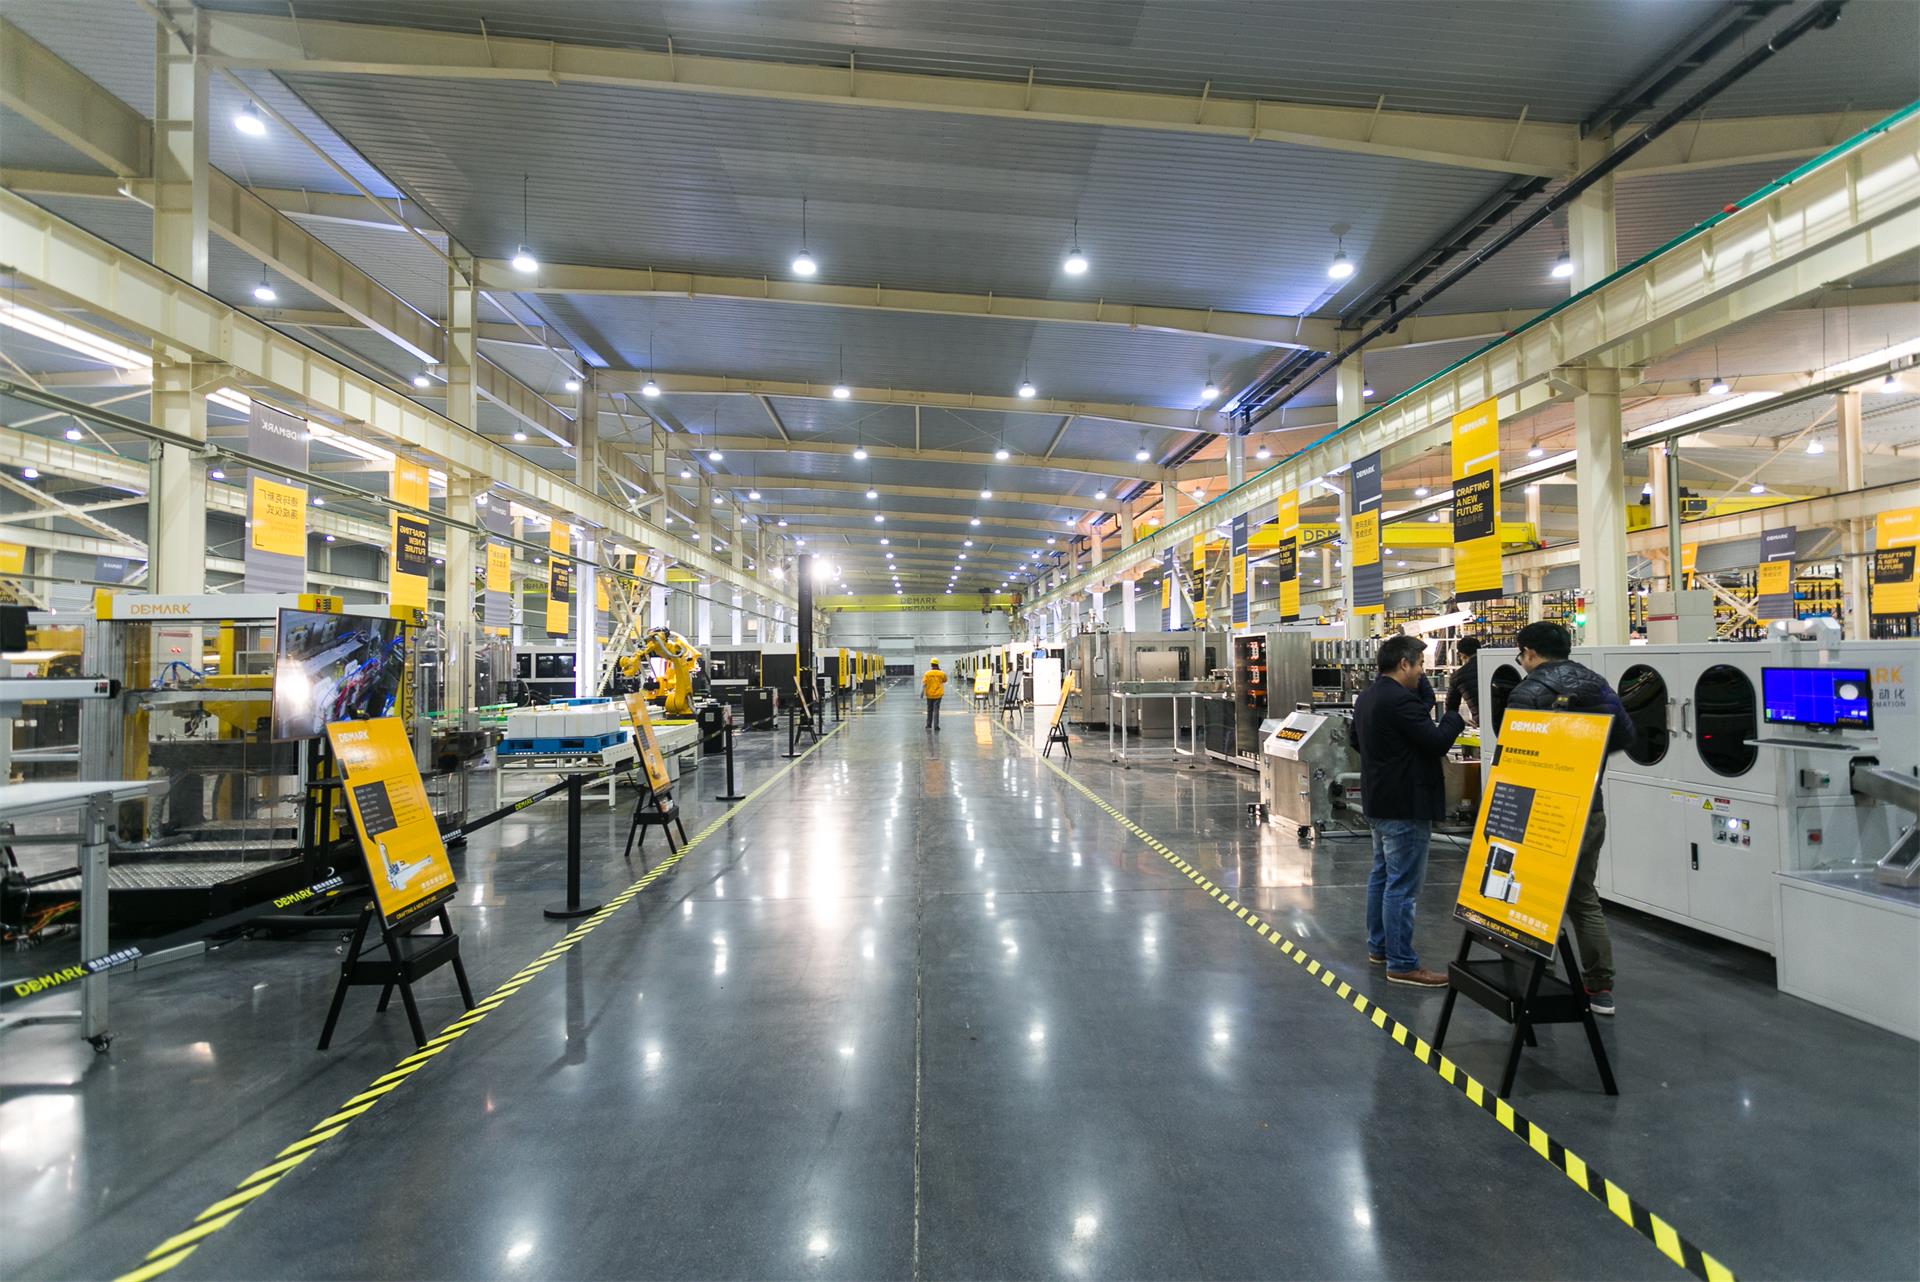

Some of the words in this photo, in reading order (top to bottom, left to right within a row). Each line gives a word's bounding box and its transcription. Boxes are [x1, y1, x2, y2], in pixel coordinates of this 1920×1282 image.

[1456, 480, 1490, 497] CRAFTING
[1456, 499, 1462, 508] A
[1462, 494, 1478, 506] NEW
[1456, 503, 1484, 517] FUTURE
[130, 603, 191, 615] DEMARK
[1510, 720, 1551, 734] DEMARK
[273, 886, 315, 909] DEMARK
[13, 962, 89, 997] DEMARK
